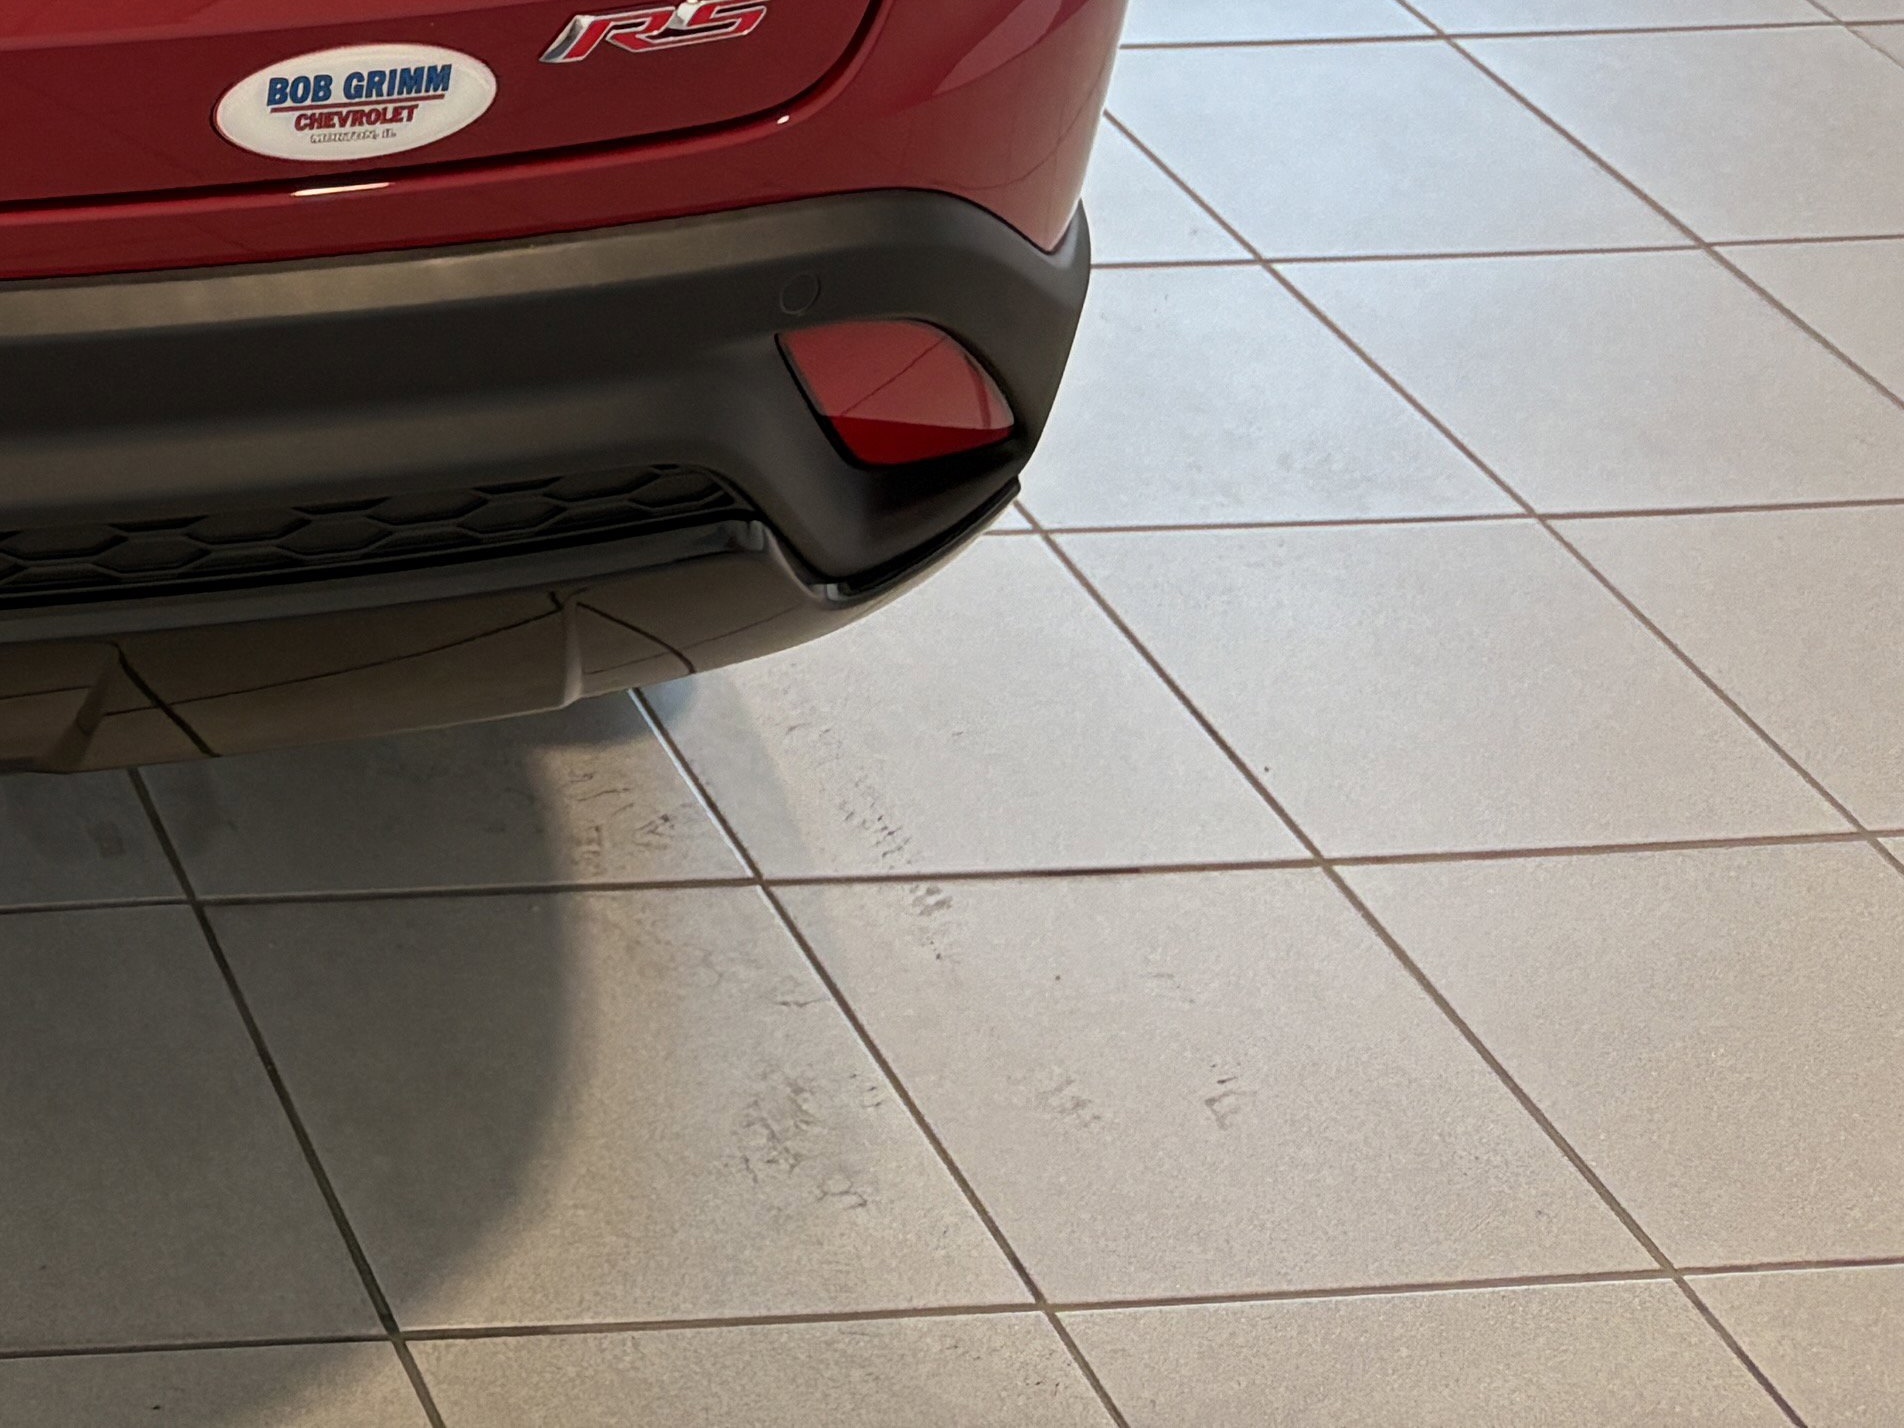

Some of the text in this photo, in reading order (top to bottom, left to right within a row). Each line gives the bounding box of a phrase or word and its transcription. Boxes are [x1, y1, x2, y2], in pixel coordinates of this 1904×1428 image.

[267, 64, 452, 106] BOB GRIMM
[294, 104, 419, 132] CHEVROLET
